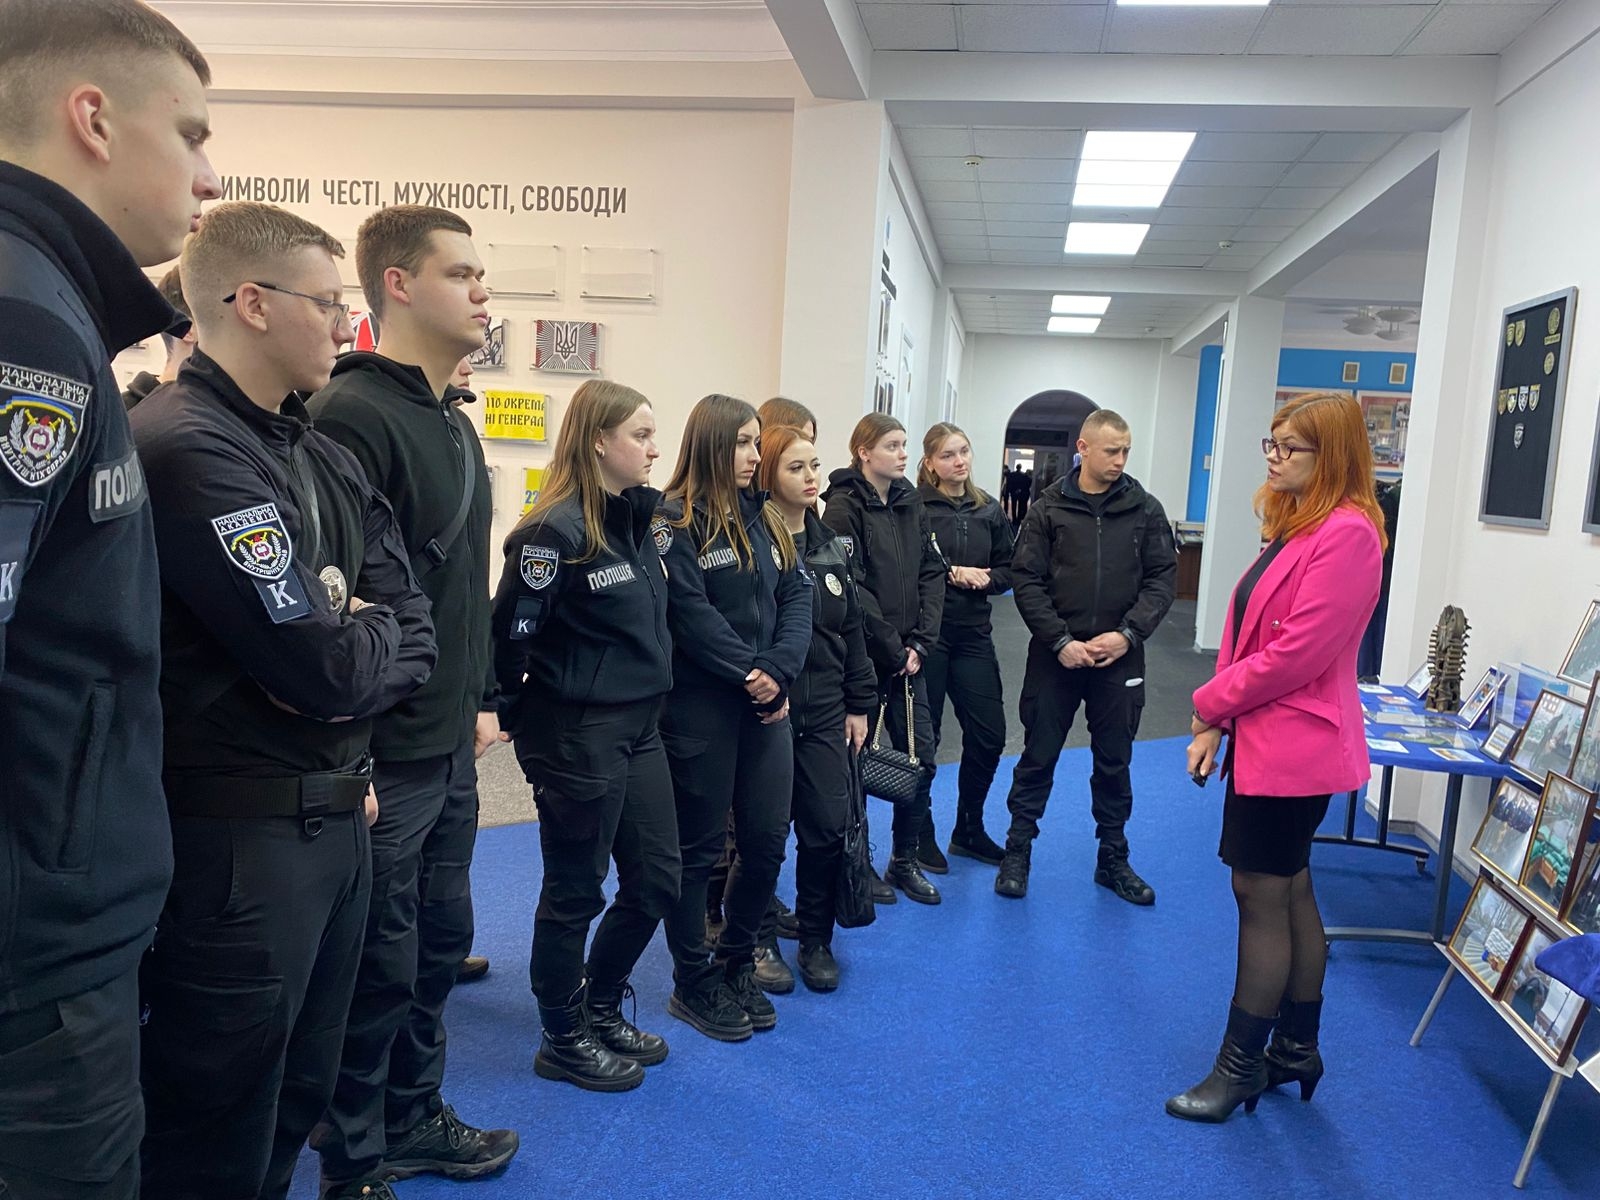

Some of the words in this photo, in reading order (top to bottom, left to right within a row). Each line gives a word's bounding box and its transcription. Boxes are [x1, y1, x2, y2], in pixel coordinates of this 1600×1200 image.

[221, 175, 309, 204] ИМВОЛИ
[323, 179, 386, 209] ЧЕСТІ,
[394, 181, 515, 215] МУЖНОСТІ,
[522, 185, 626, 218] СВОБОДИ
[0, 375, 85, 404] АКАДЕМІЯ
[1, 366, 86, 396] НАЦІОНАЛЬНА
[46, 450, 68, 475] СПРАВ
[587, 563, 635, 590] ПОЛІЦІЯ
